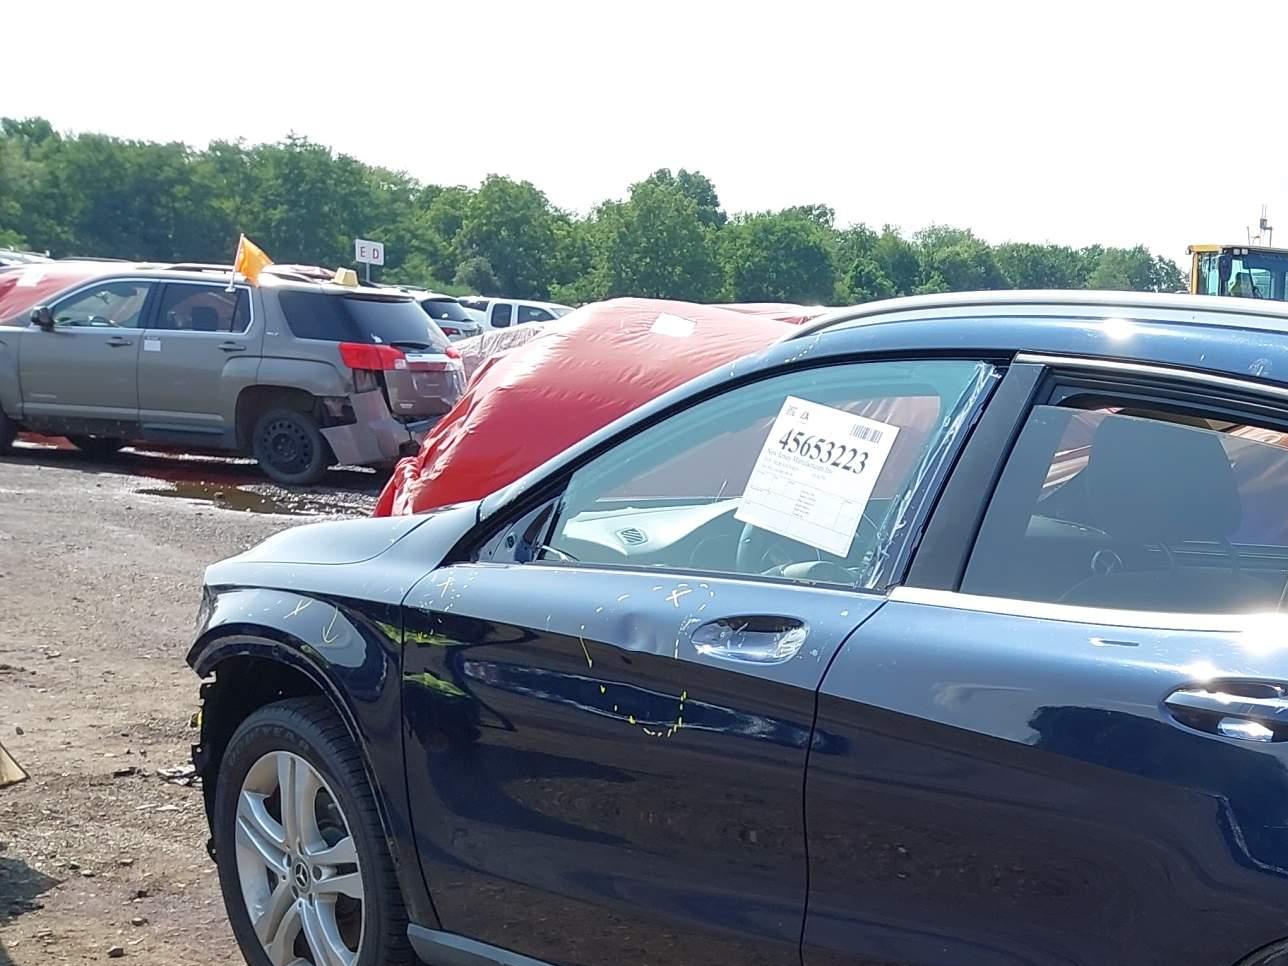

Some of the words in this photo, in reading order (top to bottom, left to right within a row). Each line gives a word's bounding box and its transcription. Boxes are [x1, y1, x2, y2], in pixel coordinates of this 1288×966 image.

[361, 246, 366, 257] E
[373, 248, 379, 259] D
[779, 428, 869, 474] 45653223
